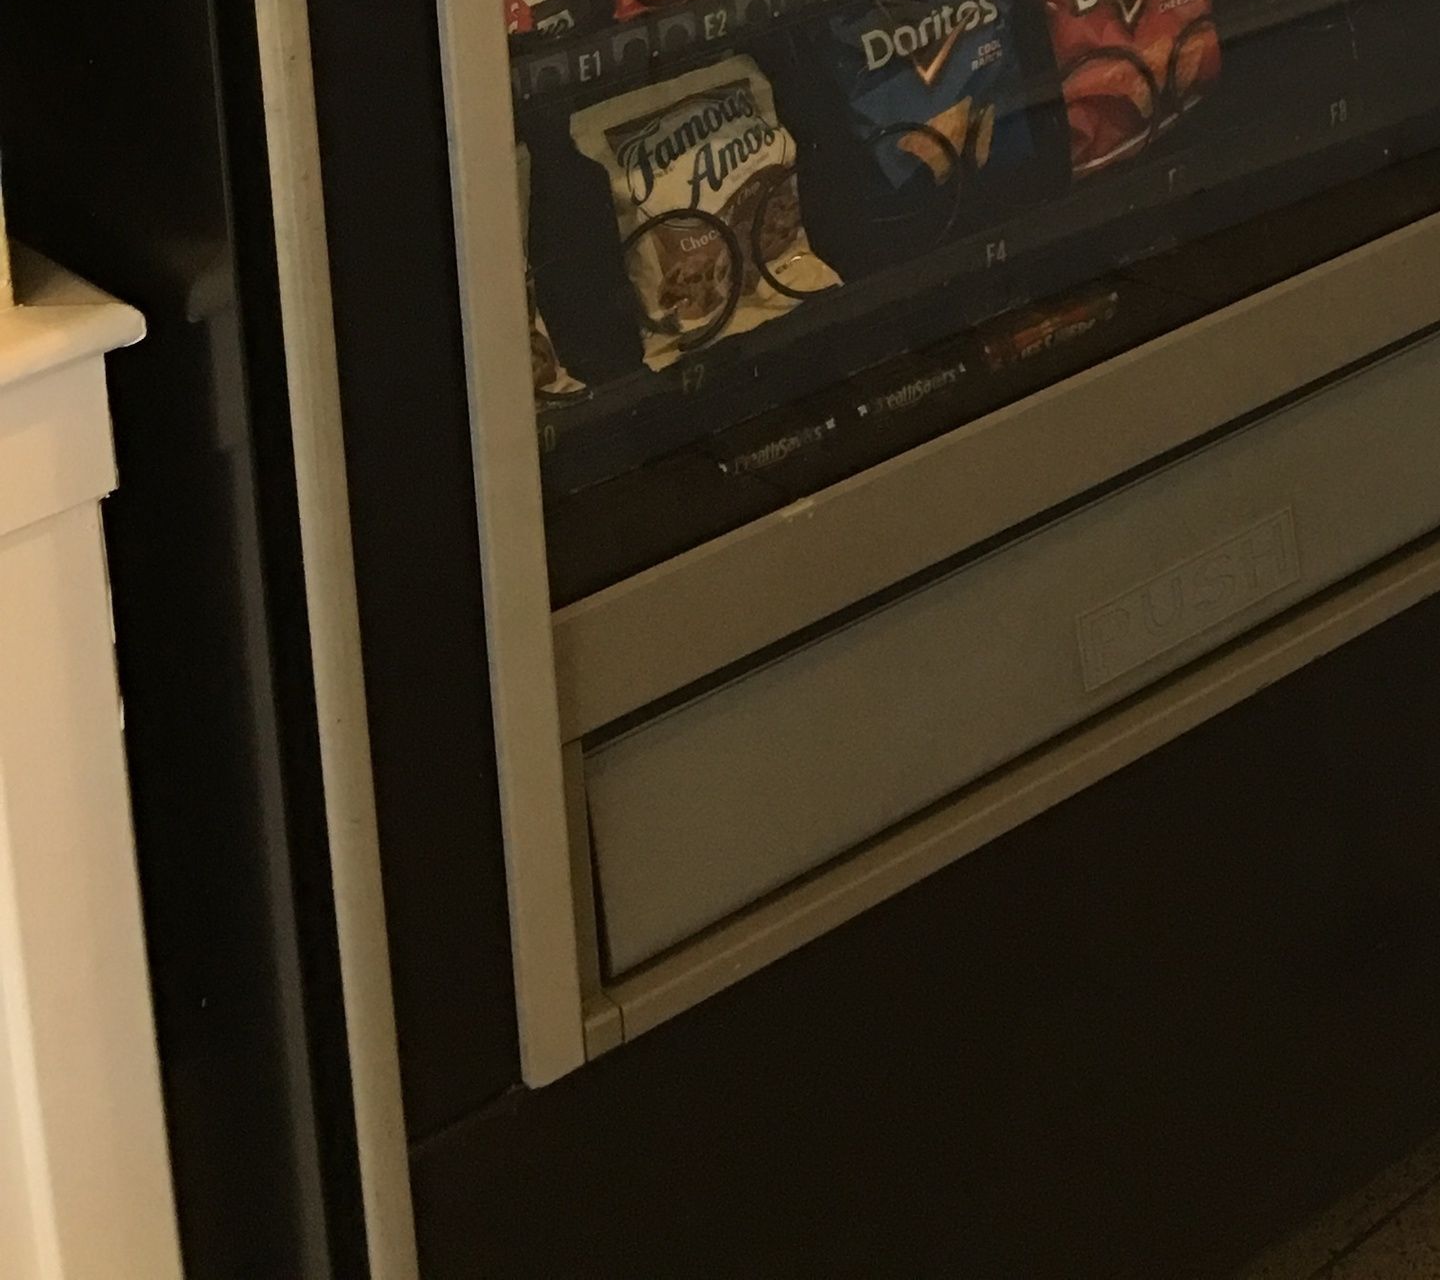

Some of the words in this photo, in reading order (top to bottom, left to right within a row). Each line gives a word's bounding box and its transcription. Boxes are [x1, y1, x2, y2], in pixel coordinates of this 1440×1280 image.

[704, 11, 728, 39] E2
[578, 50, 601, 82] E1
[617, 90, 754, 205] Famous
[688, 122, 776, 210] Amos
